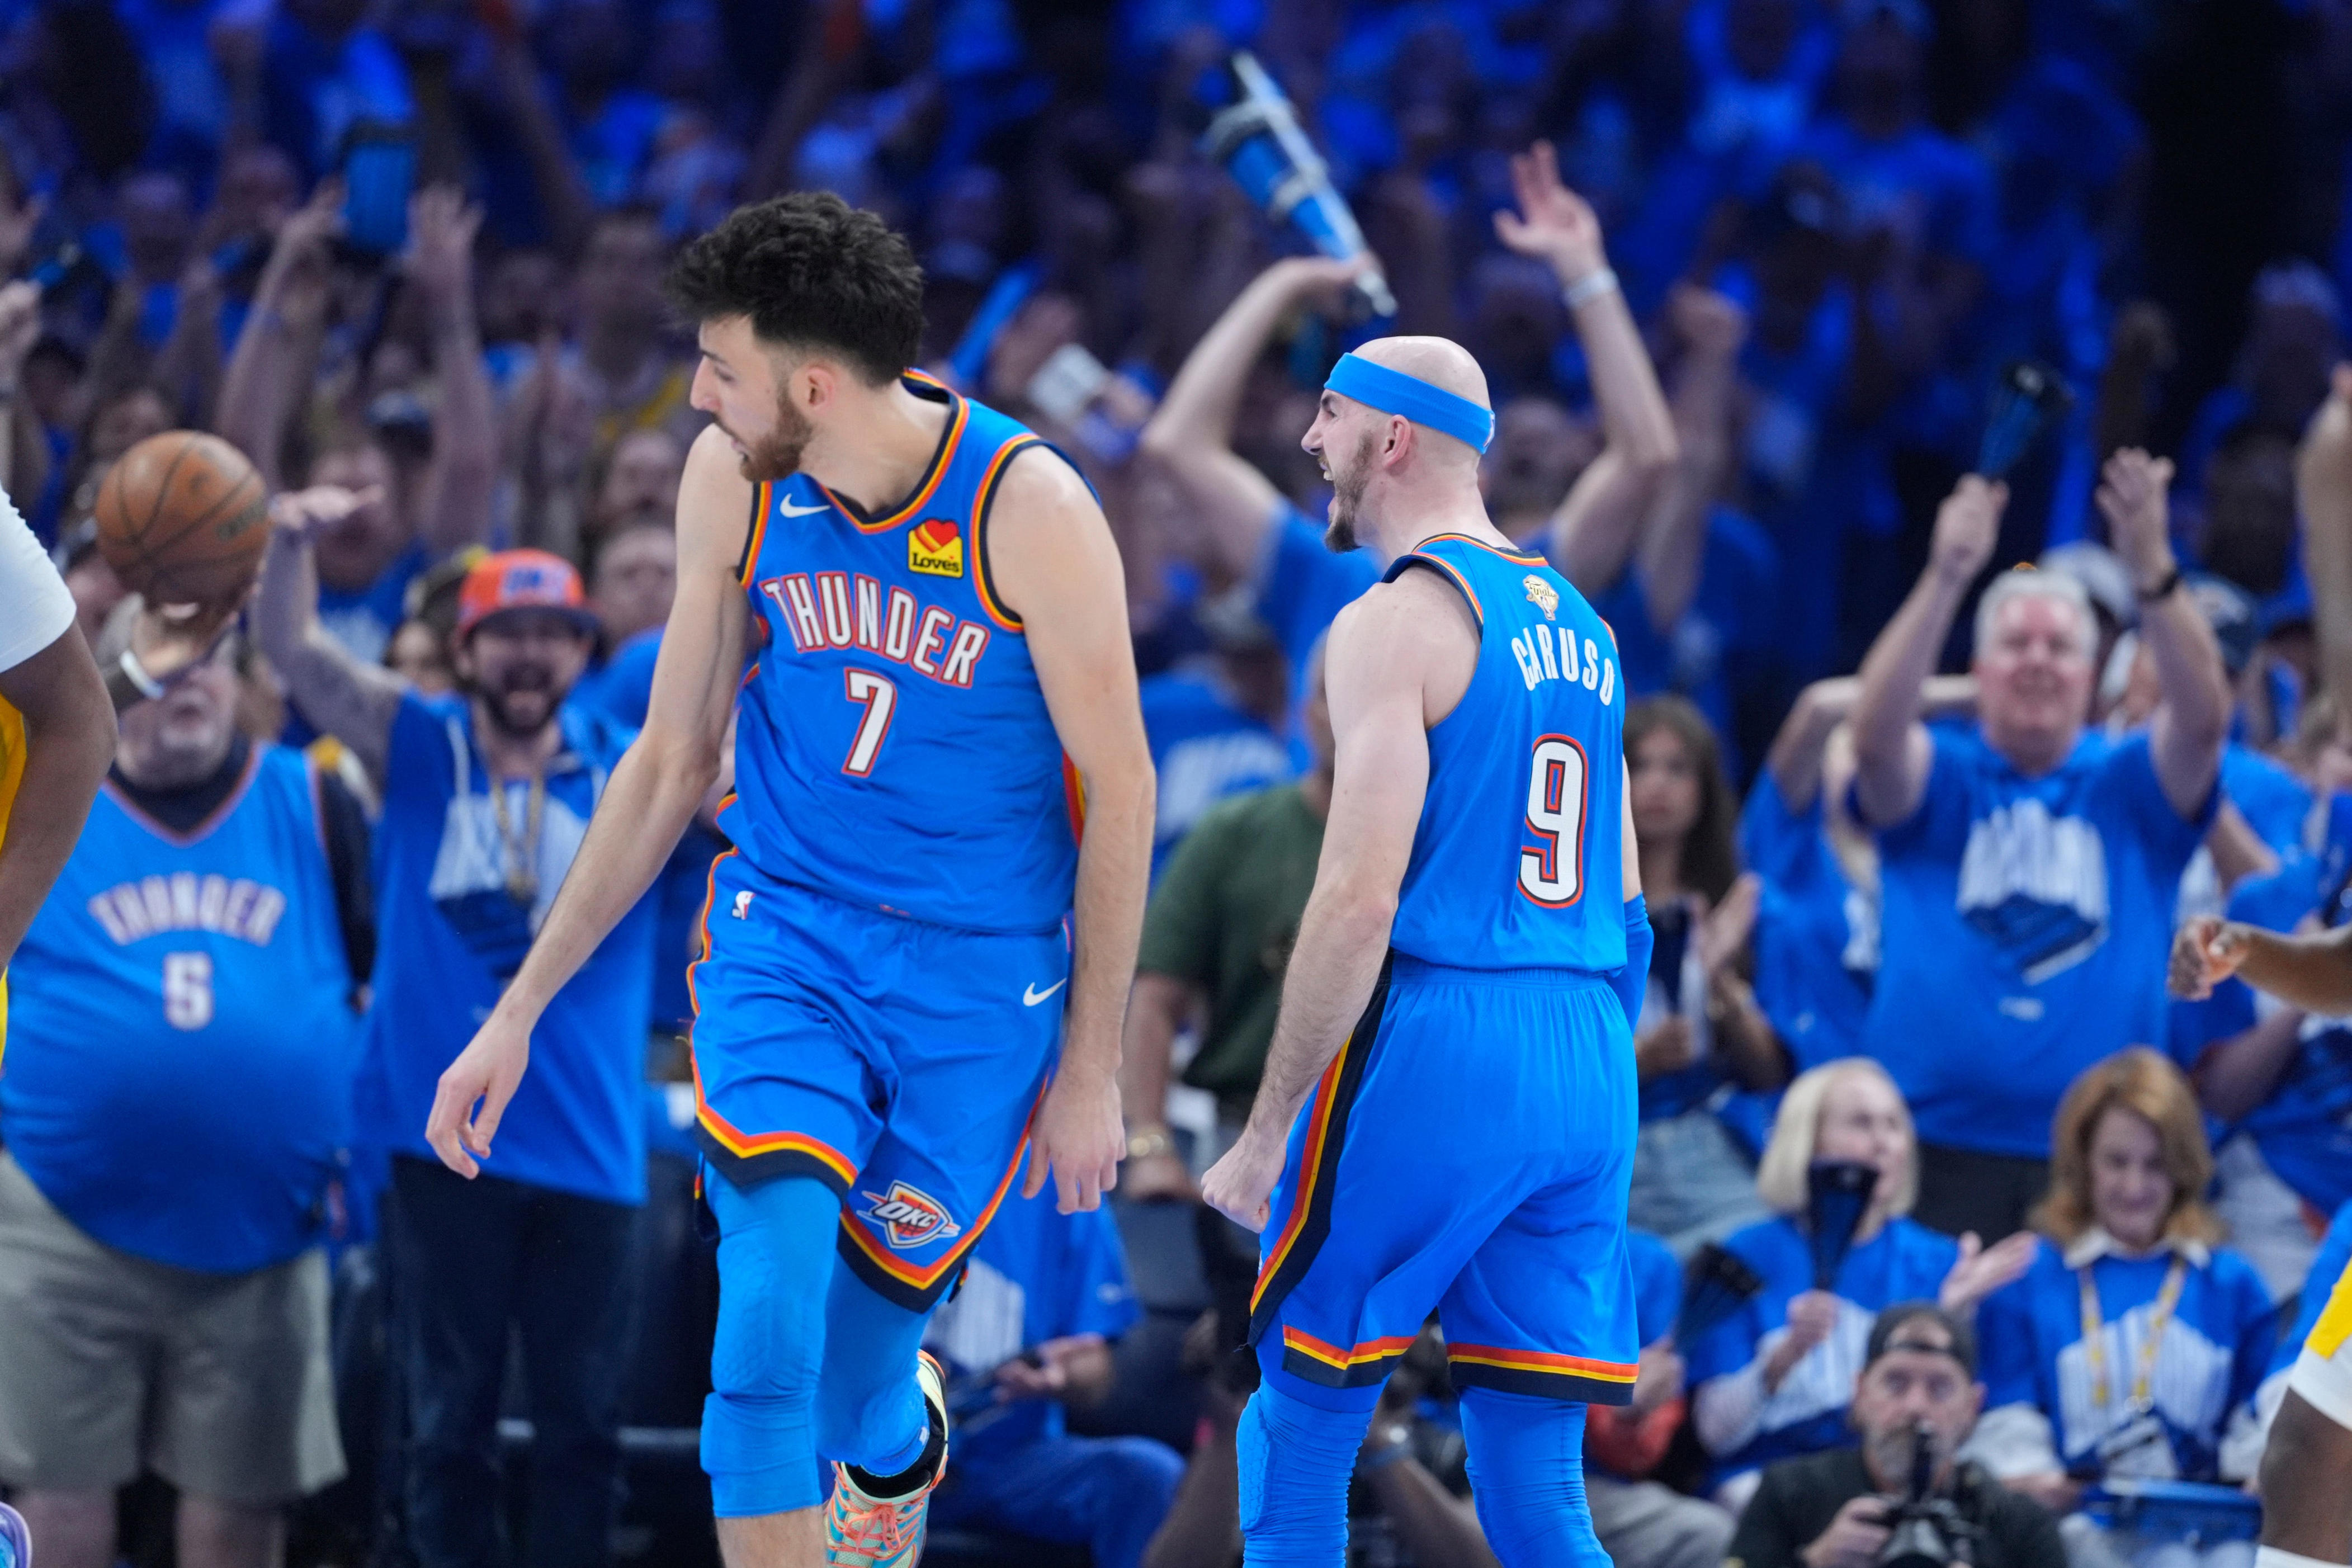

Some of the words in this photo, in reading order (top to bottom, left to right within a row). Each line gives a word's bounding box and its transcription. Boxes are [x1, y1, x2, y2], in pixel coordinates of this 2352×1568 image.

[759, 571, 990, 689] THUNDER
[1511, 624, 1615, 706] CARUSO
[842, 667, 897, 778] 7
[1517, 733, 1588, 909] 9
[872, 1201, 939, 1228] OKC
